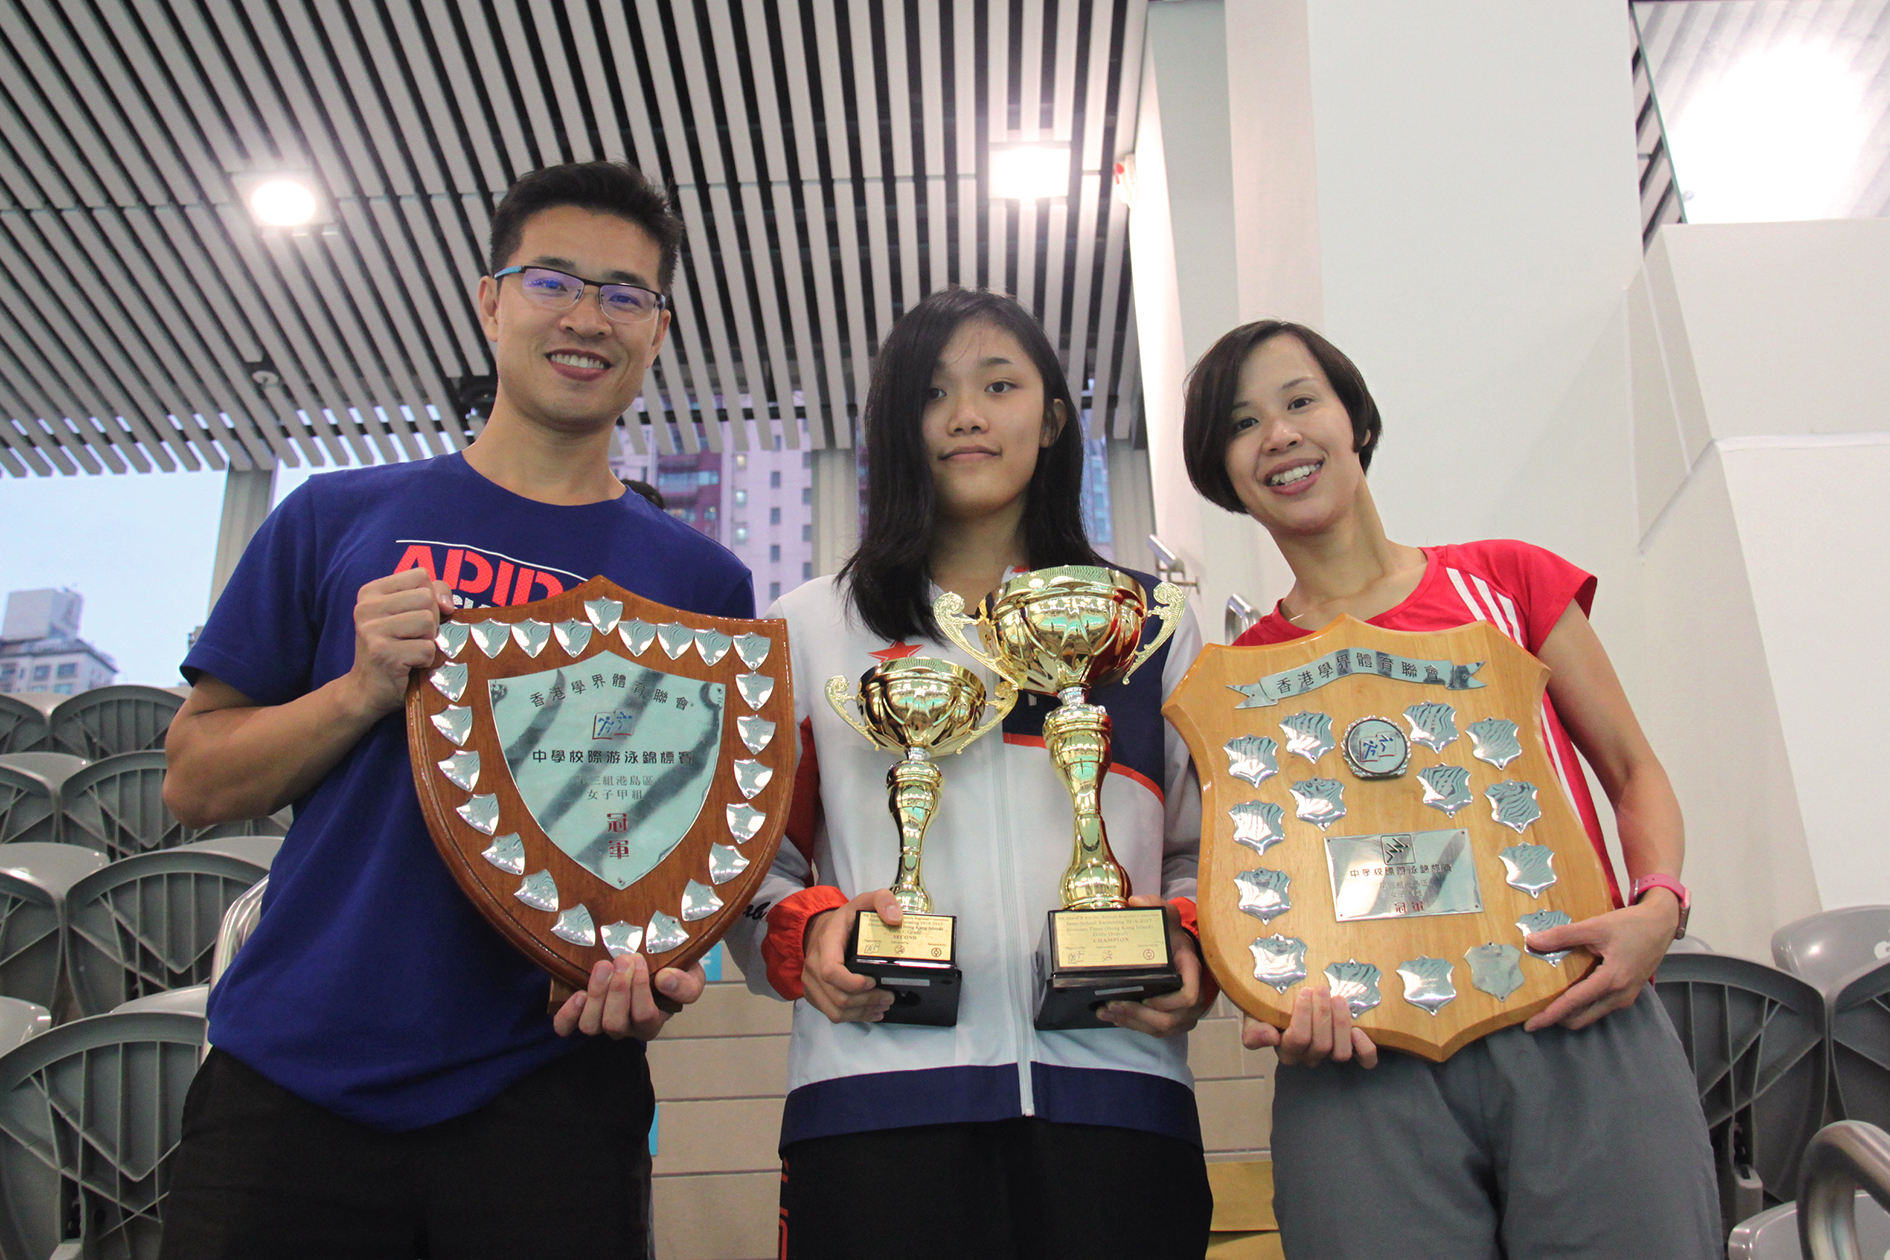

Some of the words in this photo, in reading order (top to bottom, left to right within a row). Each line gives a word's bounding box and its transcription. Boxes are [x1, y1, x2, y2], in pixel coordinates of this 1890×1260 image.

[392, 544, 583, 607] ADID
[529, 673, 690, 710] 香港學界體育聯會
[1276, 652, 1441, 694] 香港學界體育聯會
[532, 749, 694, 765] 中學校際游泳錦標賽
[586, 790, 644, 801] 女子甲組
[606, 812, 630, 860] 冠軍
